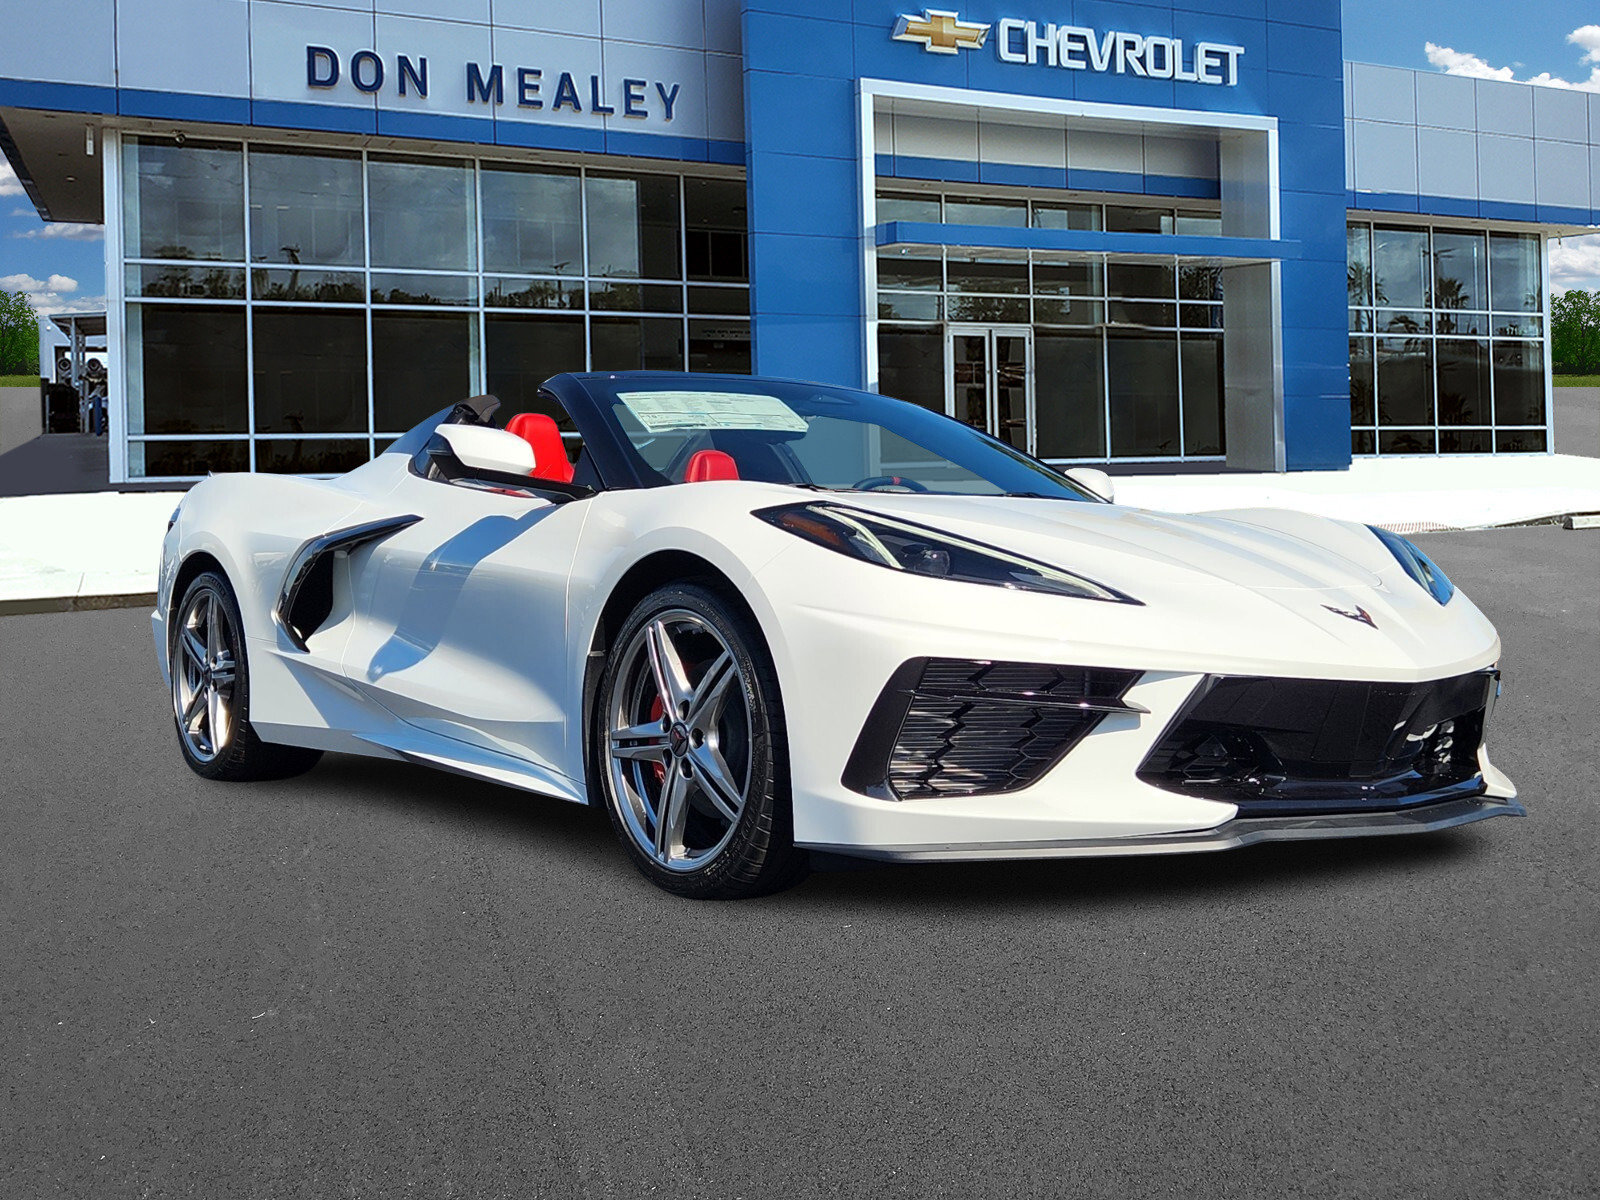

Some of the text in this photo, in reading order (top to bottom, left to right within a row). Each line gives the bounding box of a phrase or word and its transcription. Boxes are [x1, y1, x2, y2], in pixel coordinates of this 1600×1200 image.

[306, 45, 680, 122] DON MEALEY
[998, 17, 1245, 87] CHEVROLET
